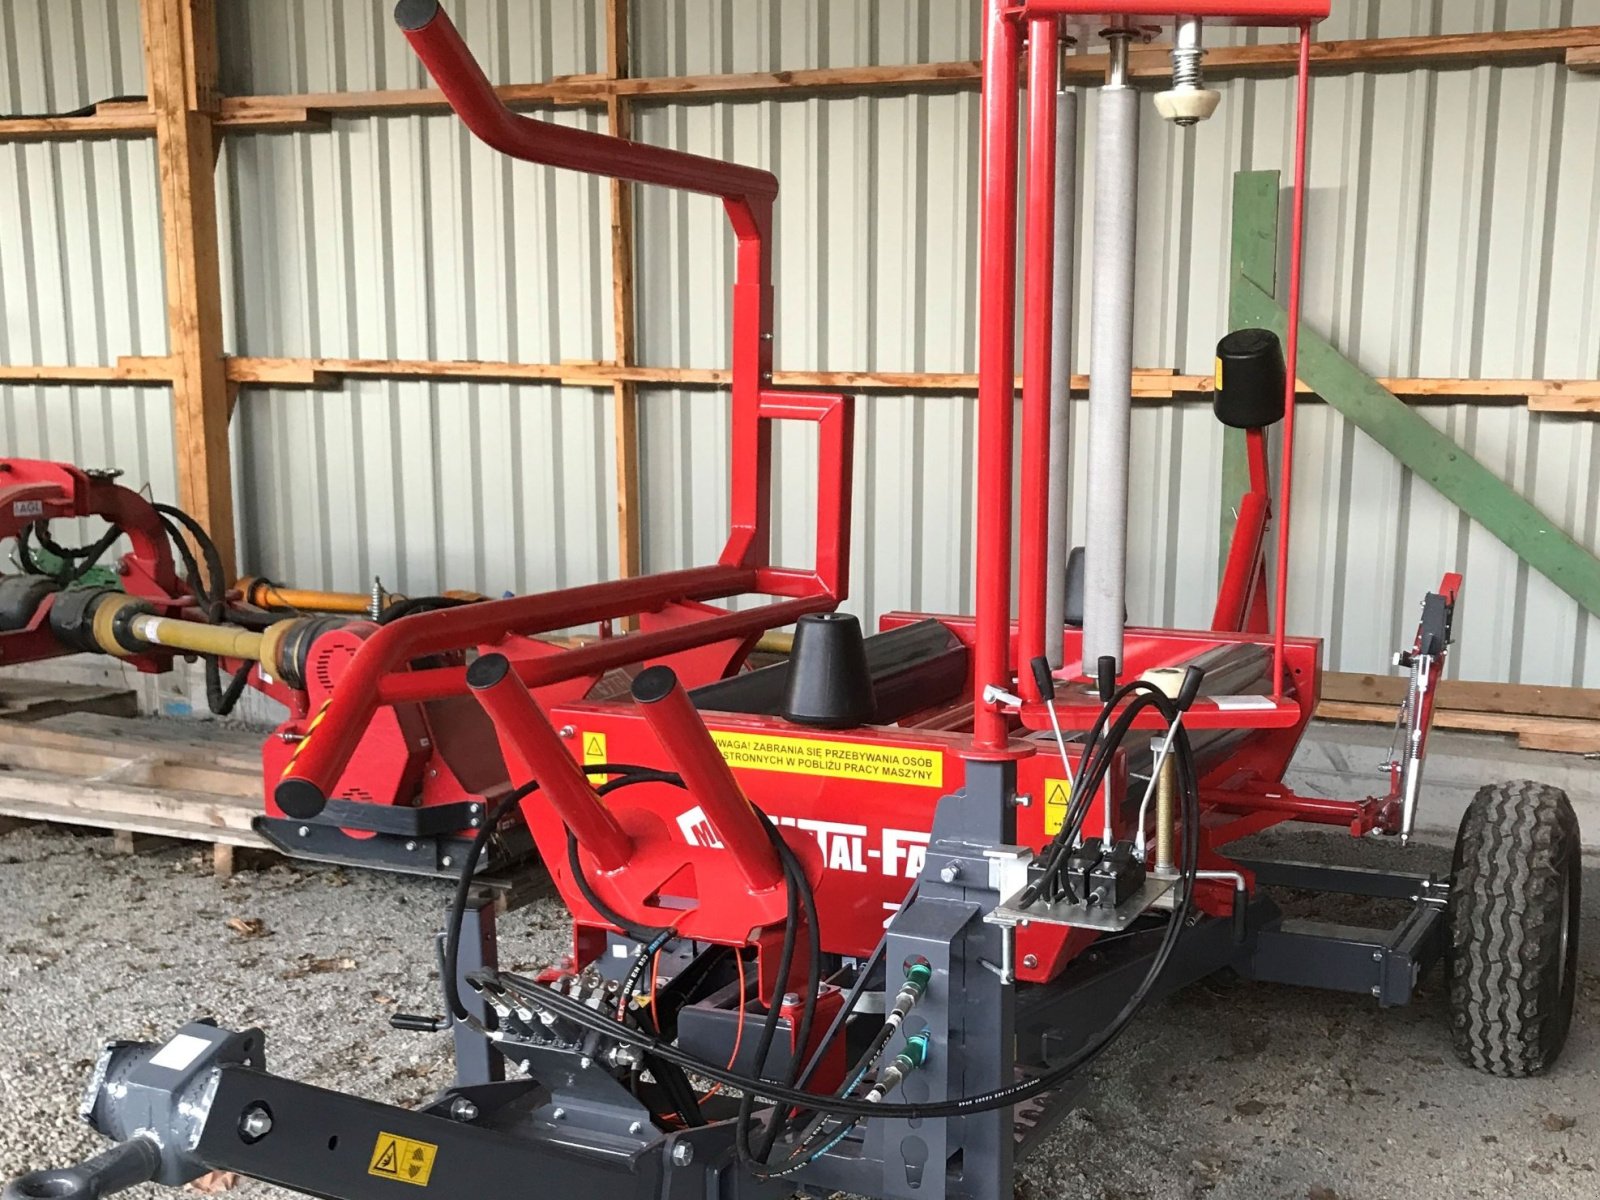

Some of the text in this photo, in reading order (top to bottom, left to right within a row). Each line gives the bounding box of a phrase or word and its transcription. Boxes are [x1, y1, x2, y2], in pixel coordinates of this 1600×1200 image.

[722, 751, 933, 780] STRONNYCH W POBLIŻU PRACY MASZYNY
[753, 742, 804, 755] ZABRANIA
[806, 747, 823, 759] SIĘ
[825, 748, 900, 764] PRZEBYWANIA
[902, 755, 933, 768] OSÓB
[766, 815, 931, 879] TAL-FA
[623, 979, 634, 995] DIN
[630, 966, 641, 979] EN
